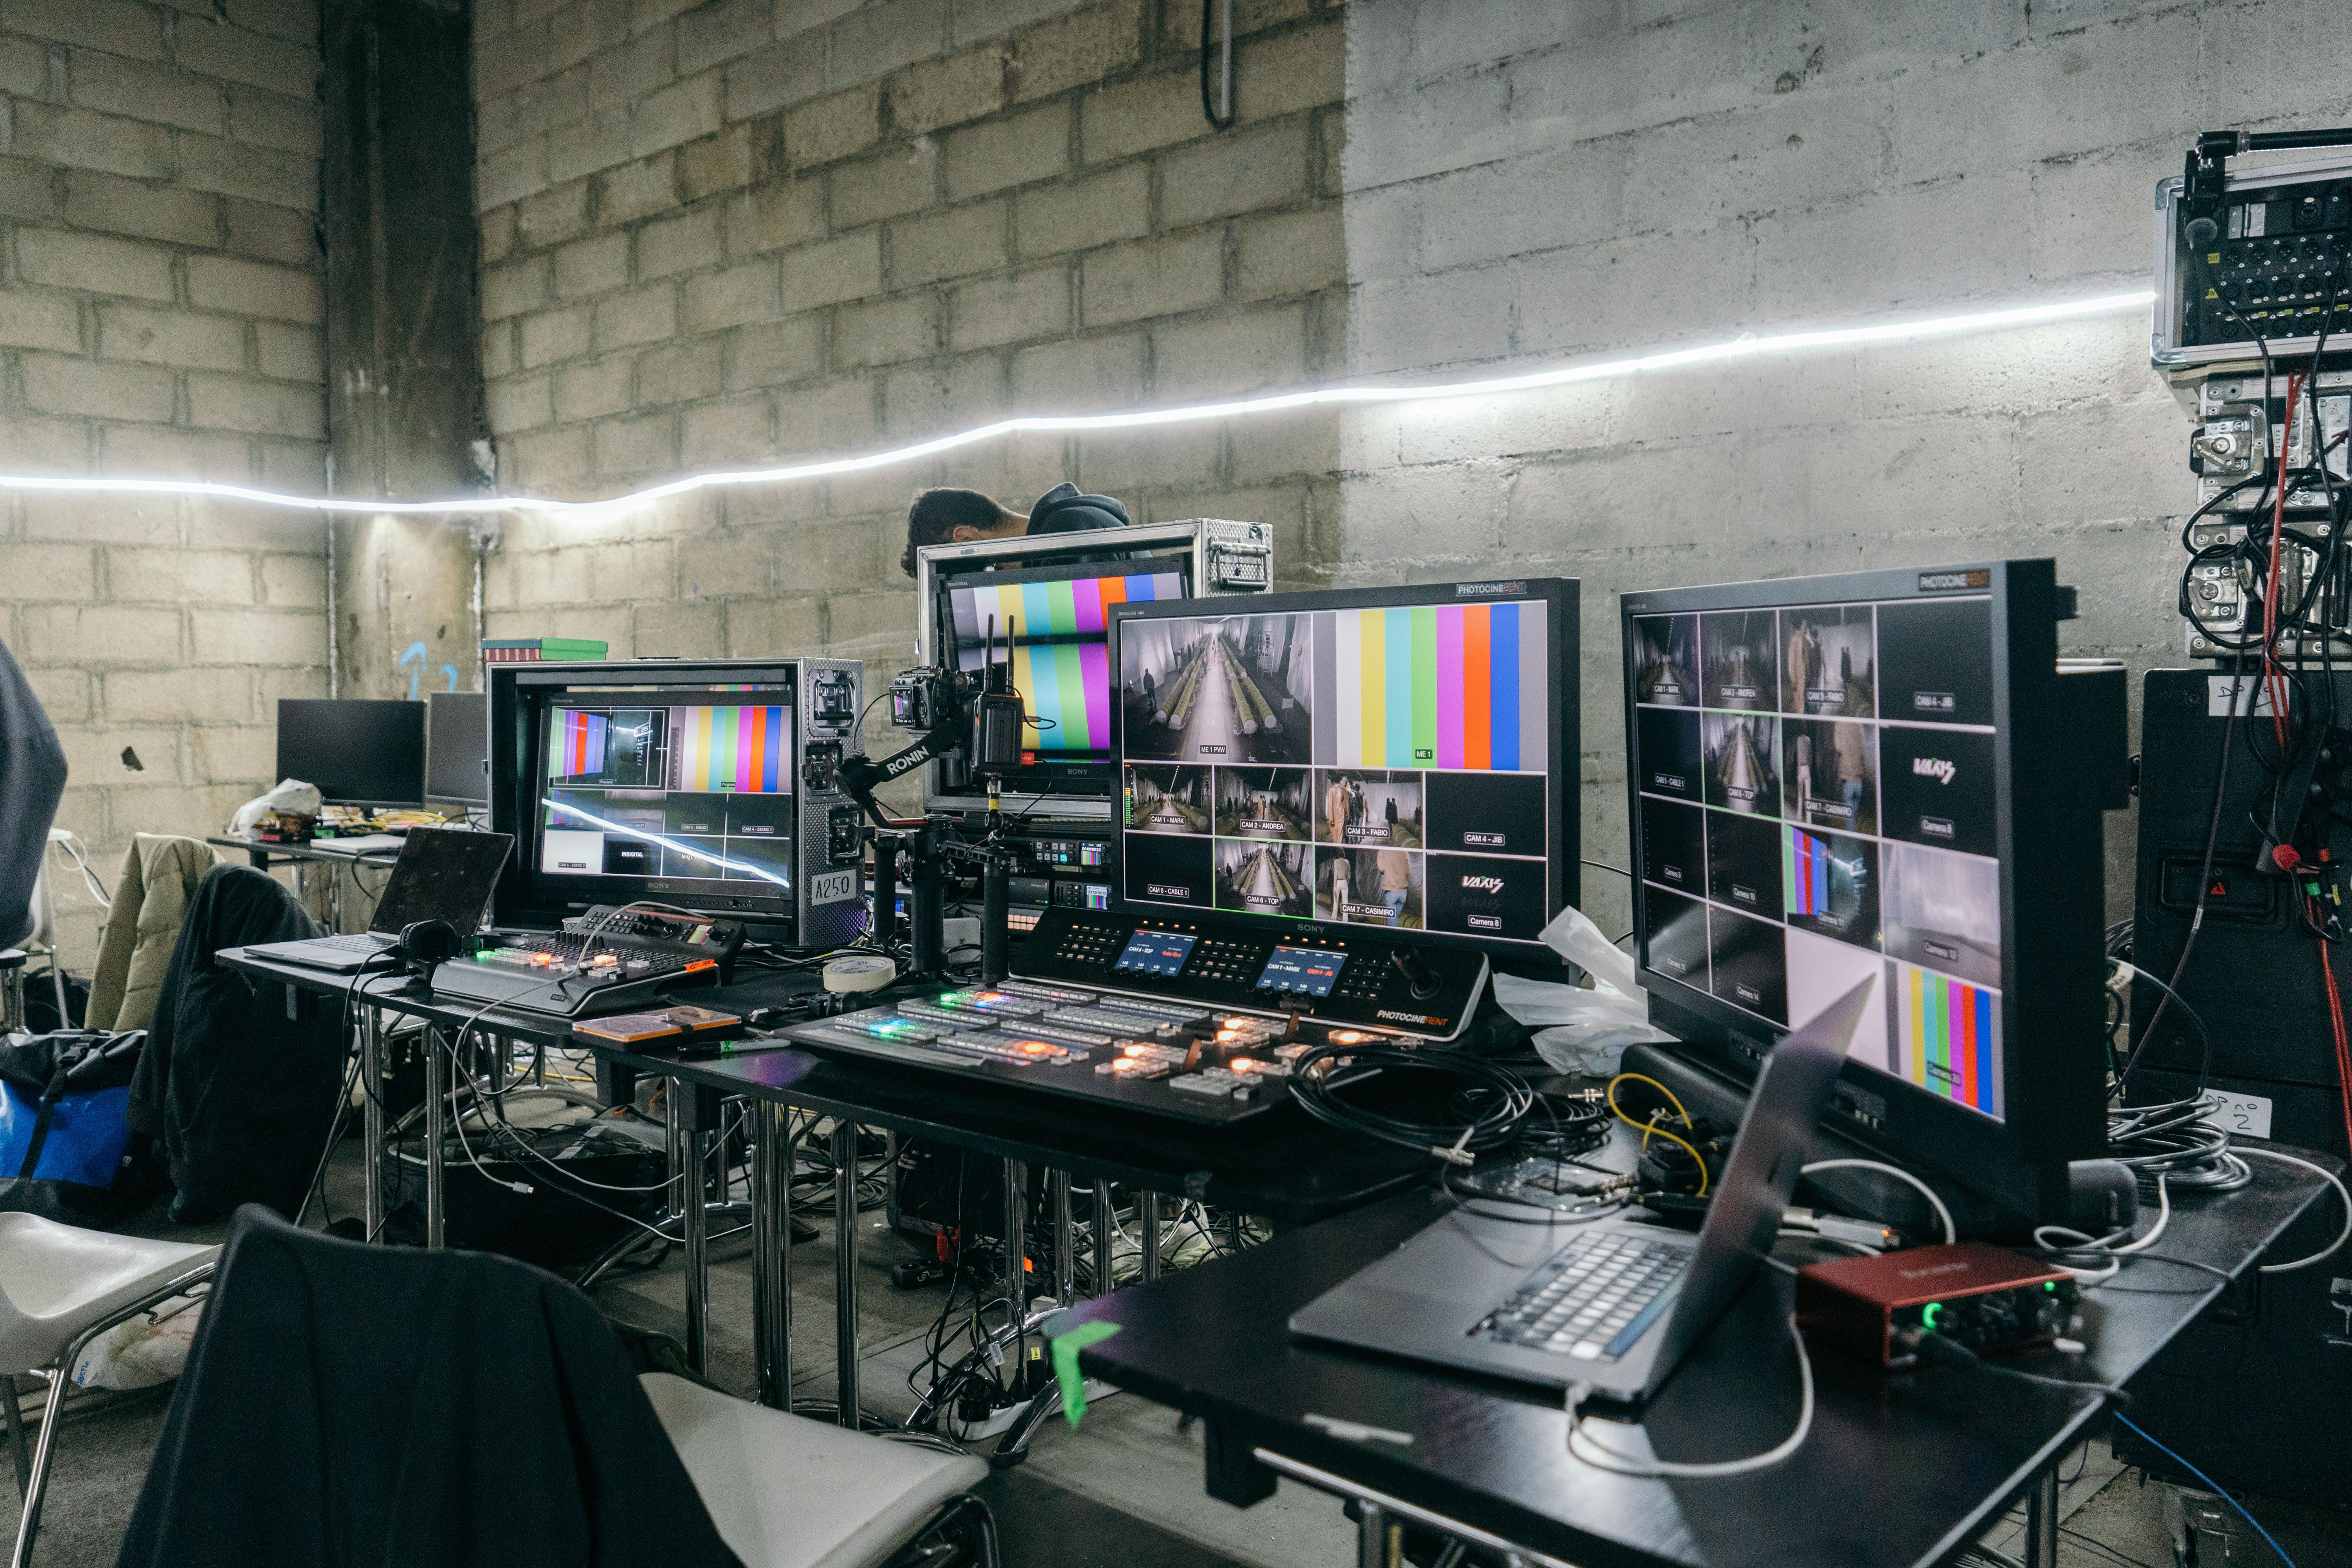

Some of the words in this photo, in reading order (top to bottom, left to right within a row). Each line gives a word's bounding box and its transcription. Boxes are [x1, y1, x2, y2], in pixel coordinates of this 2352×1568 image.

[887, 746, 929, 775] RONIN
[815, 876, 850, 899] A250
[1462, 876, 1504, 894] VAXIS
[1365, 907, 1394, 916] CASIMIRO
[1297, 923, 1325, 933] SONY
[1470, 917, 1494, 926] Camera
[1377, 1010, 1448, 1026] PHOTOCINERENT
[2234, 1114, 2251, 1130] 2
